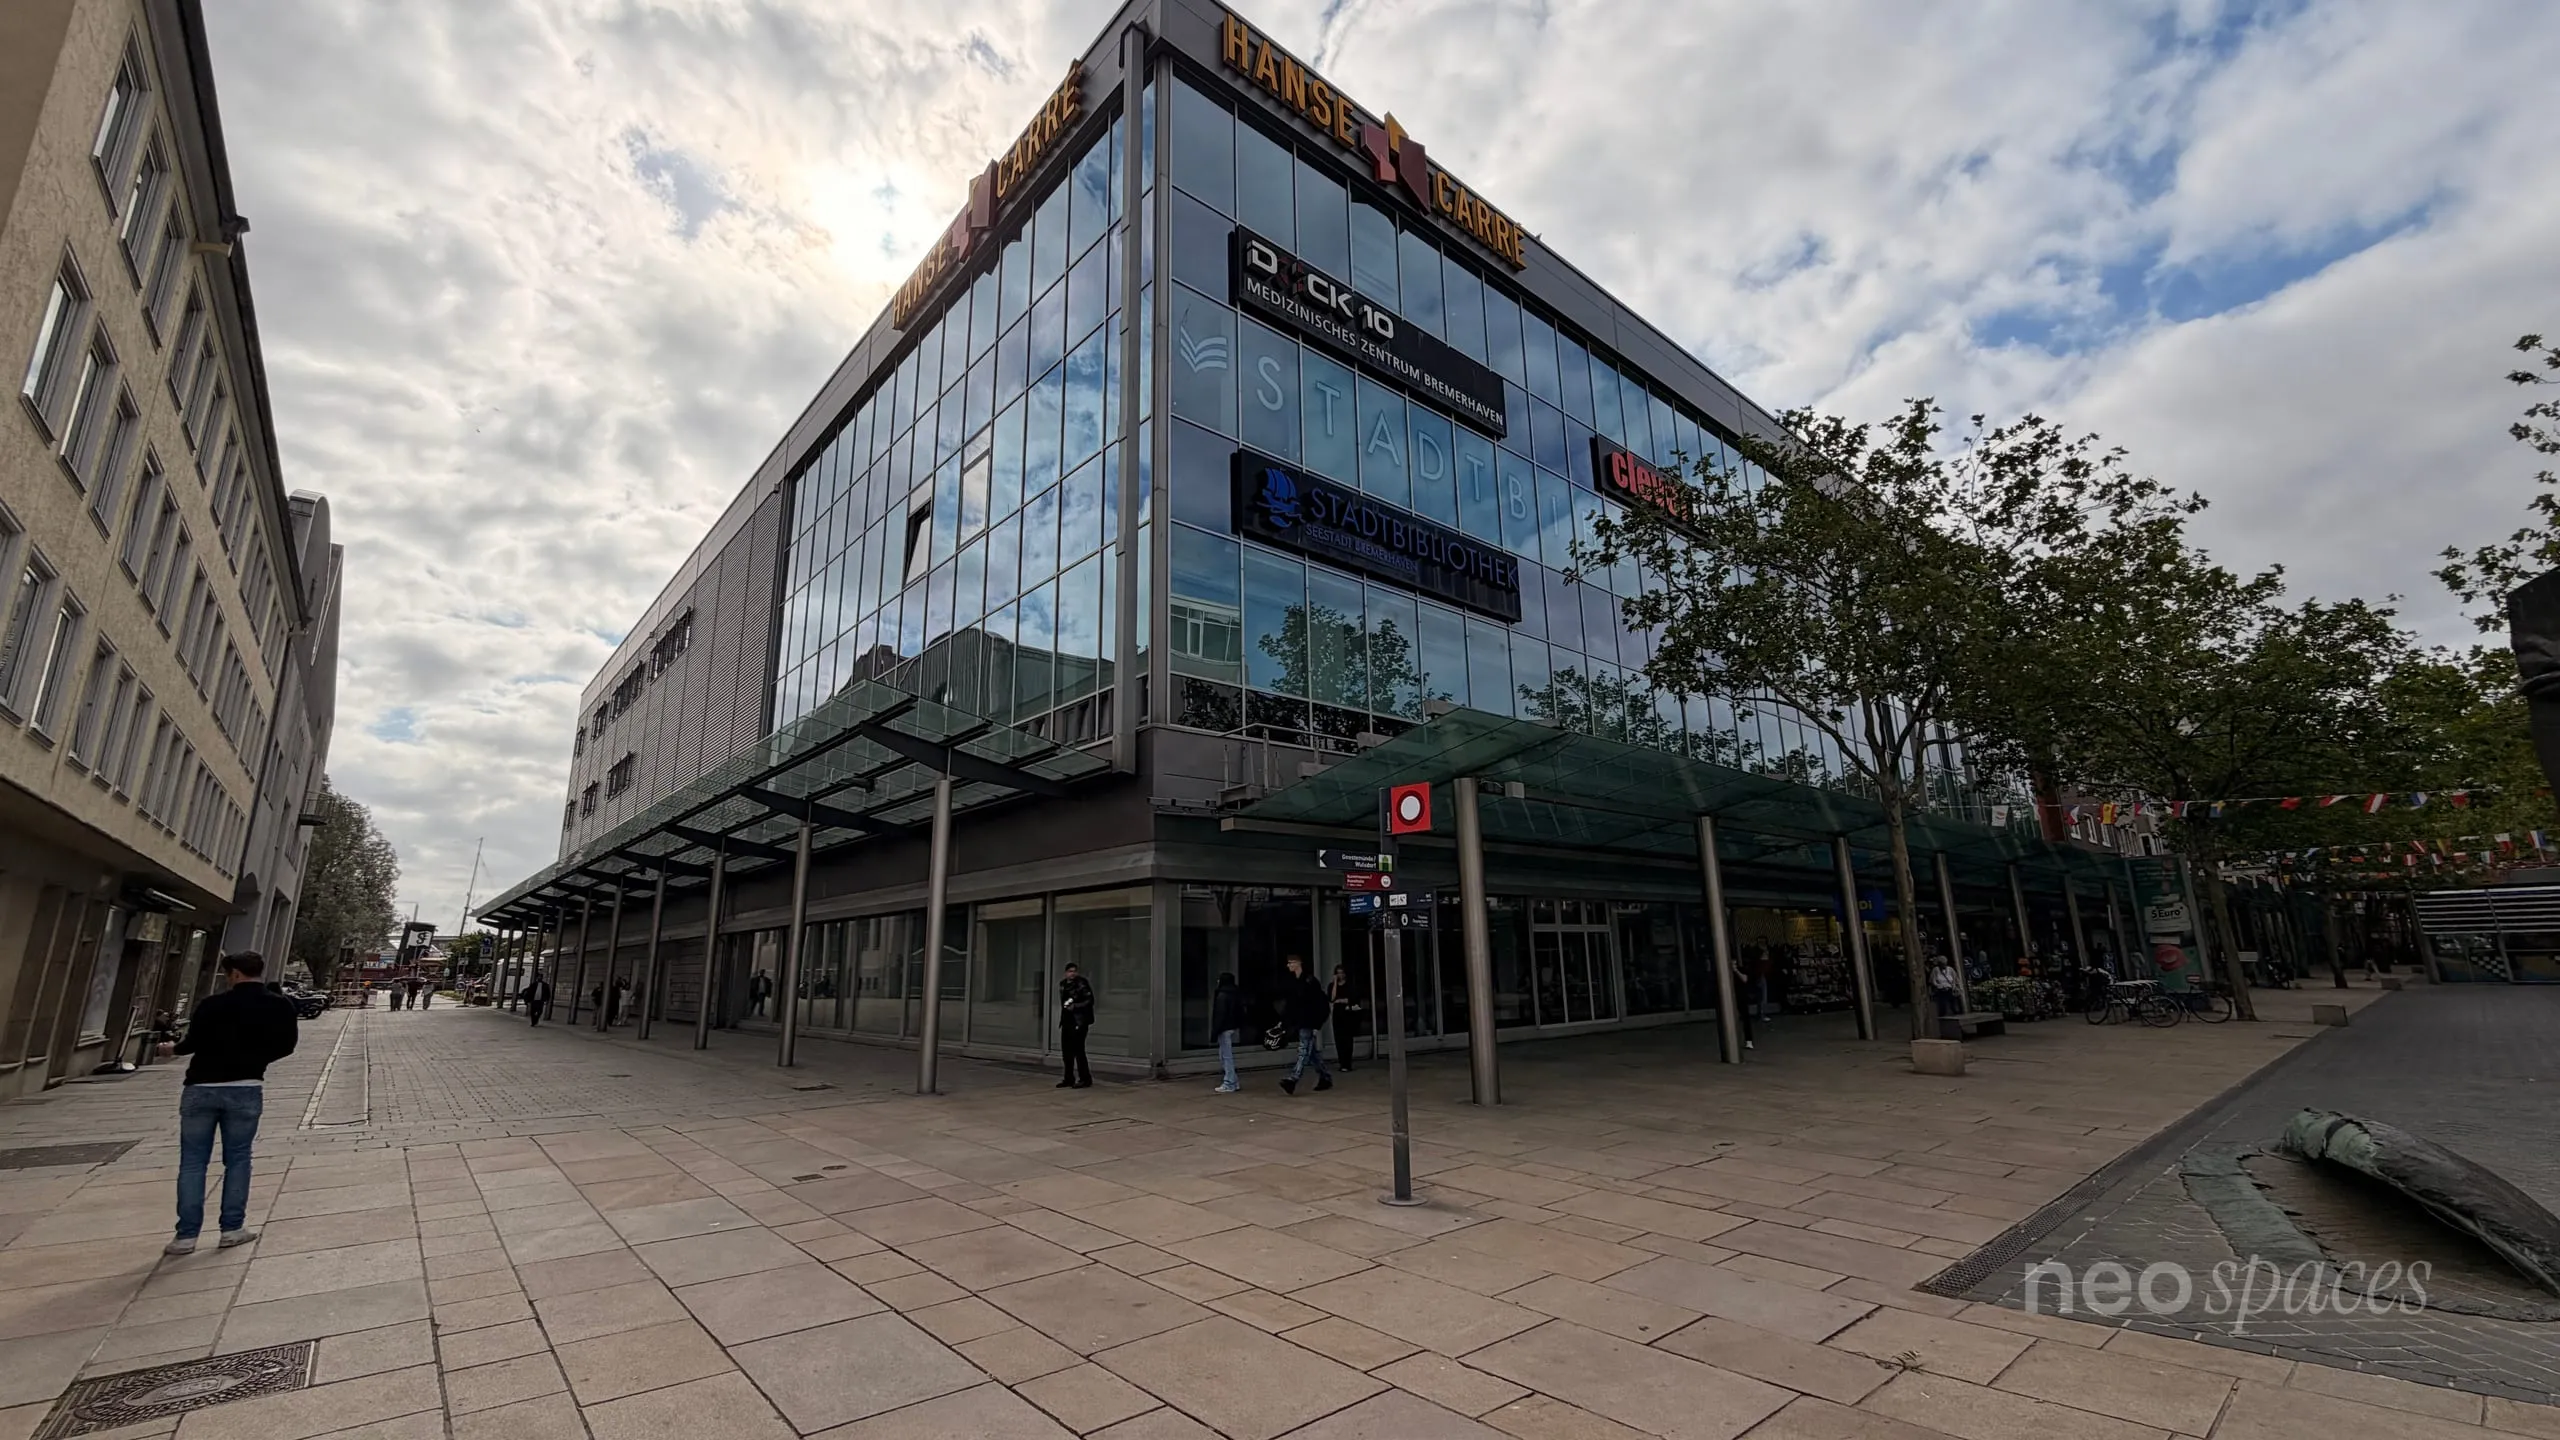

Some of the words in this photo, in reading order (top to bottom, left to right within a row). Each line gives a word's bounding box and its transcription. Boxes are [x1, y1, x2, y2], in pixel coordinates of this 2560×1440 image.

[1222, 12, 1356, 147] HANSE
[1433, 169, 1528, 271] CARRÉ
[892, 242, 950, 331] HANSE
[996, 58, 1083, 200] CARRÉ
[1246, 276, 1357, 347] MEDIZINISCHES
[1359, 337, 1421, 382] ZENTRUM
[1423, 372, 1504, 427] BREMERHAVEN
[1360, 301, 1395, 340] 10
[1305, 523, 1353, 549] SEESTADT
[1355, 539, 1419, 575] BREMERHAVEN
[1310, 486, 1520, 591] STADTBIBLIOTHEK
[2151, 909, 2158, 919] 5
